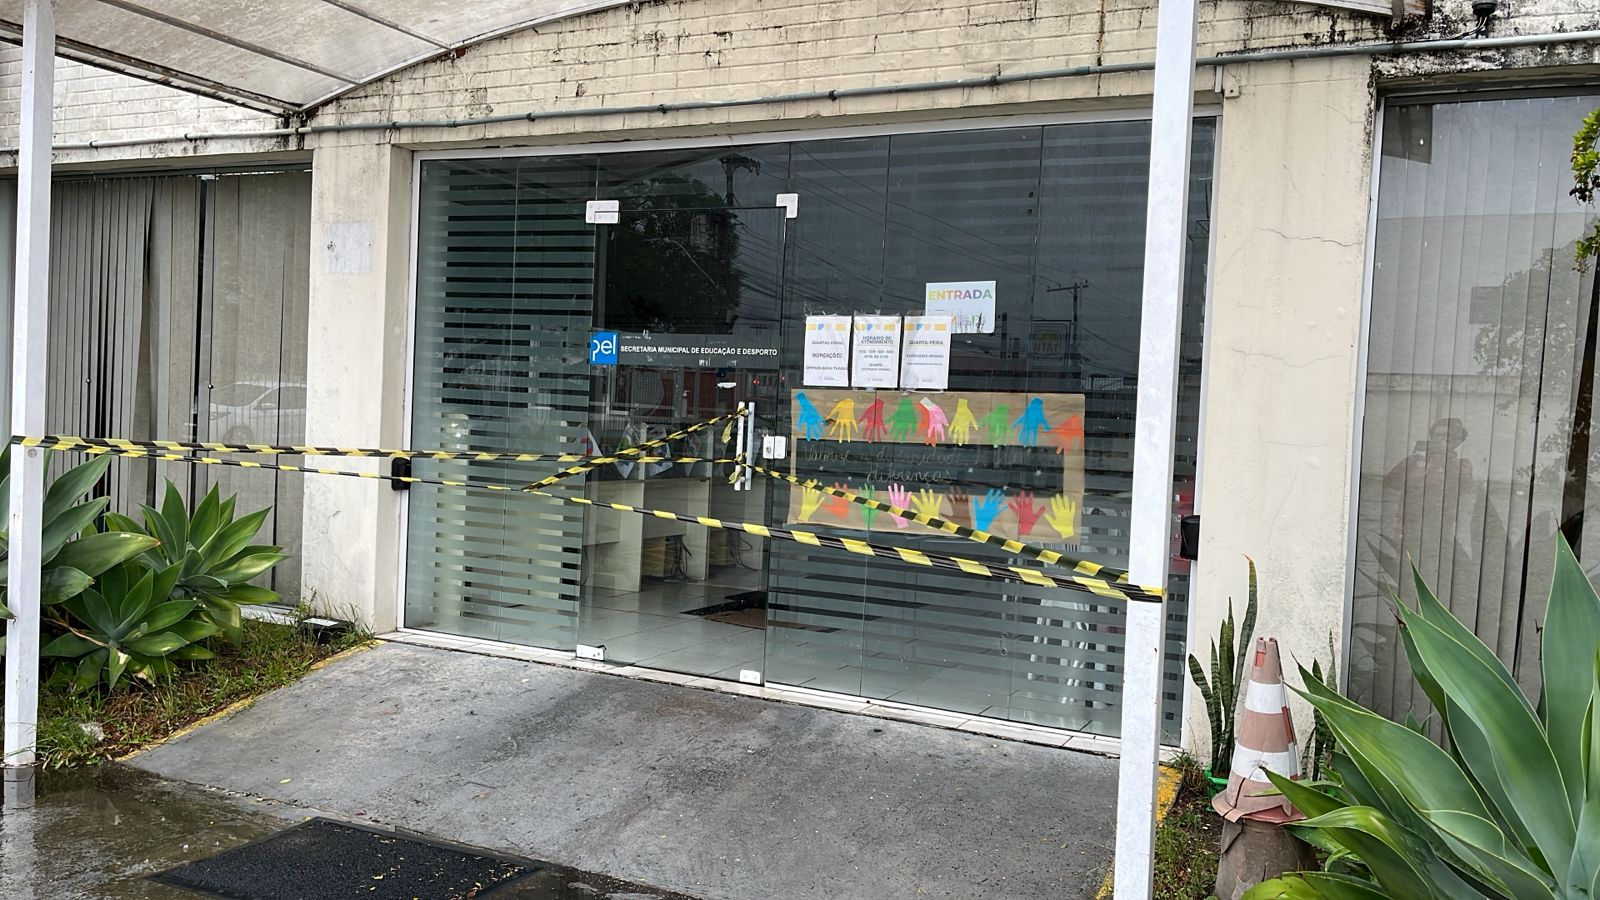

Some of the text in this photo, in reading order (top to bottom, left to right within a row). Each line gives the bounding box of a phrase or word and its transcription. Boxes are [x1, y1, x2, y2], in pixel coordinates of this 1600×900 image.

[928, 288, 992, 300] ENTRADA
[620, 345, 657, 353] SECRETARIA
[658, 346, 690, 354] MUNICIPAL
[701, 346, 736, 356] EDUCAÇÃO
[737, 347, 742, 355] E
[742, 348, 778, 356] DESPORTO
